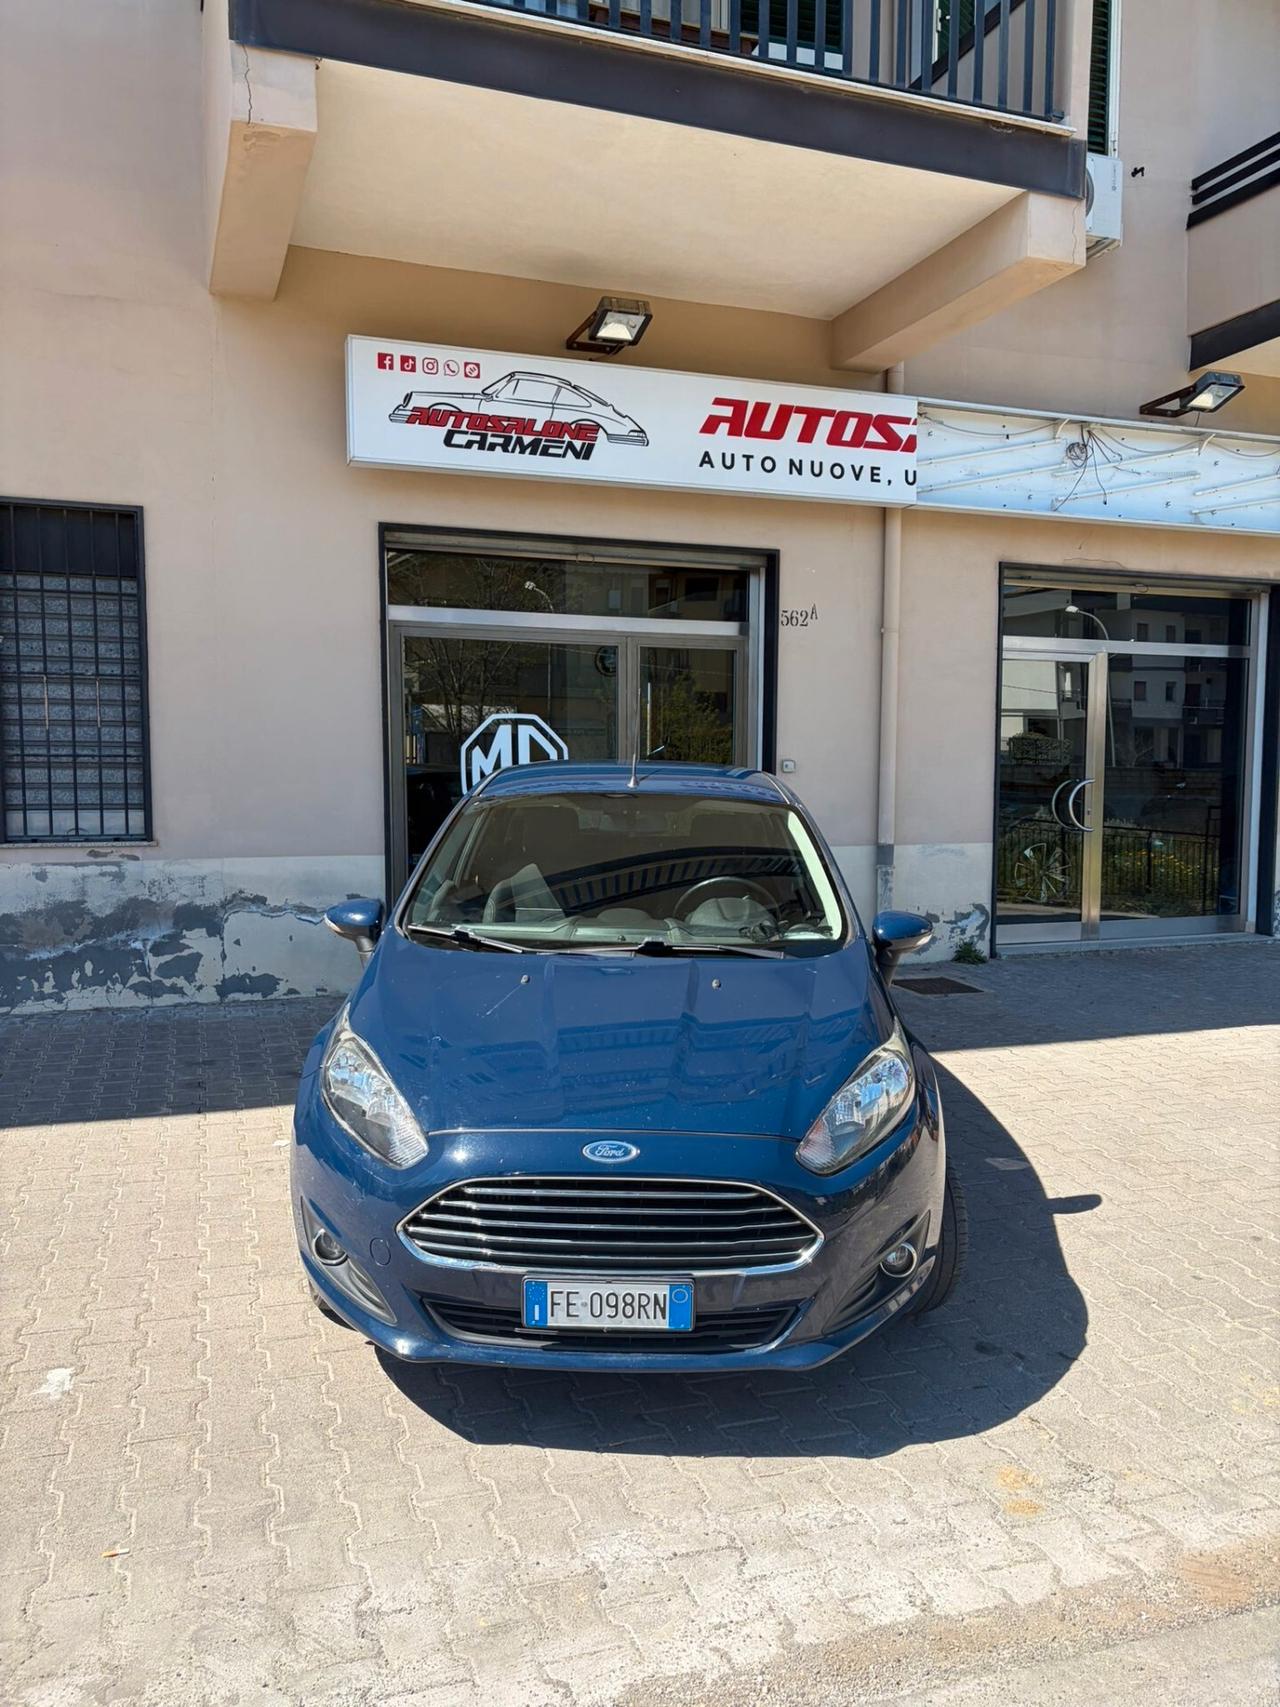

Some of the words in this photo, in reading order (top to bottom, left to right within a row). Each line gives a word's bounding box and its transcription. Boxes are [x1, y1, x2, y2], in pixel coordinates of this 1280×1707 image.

[406, 406, 600, 441] AUTOSALONE
[443, 429, 596, 461] CARMENI
[699, 450, 777, 474] AUTO
[788, 458, 892, 486] NUOVE,
[595, 1144, 625, 1157] Ford
[550, 1290, 579, 1318] FE
[589, 1291, 666, 1320] 098RN
